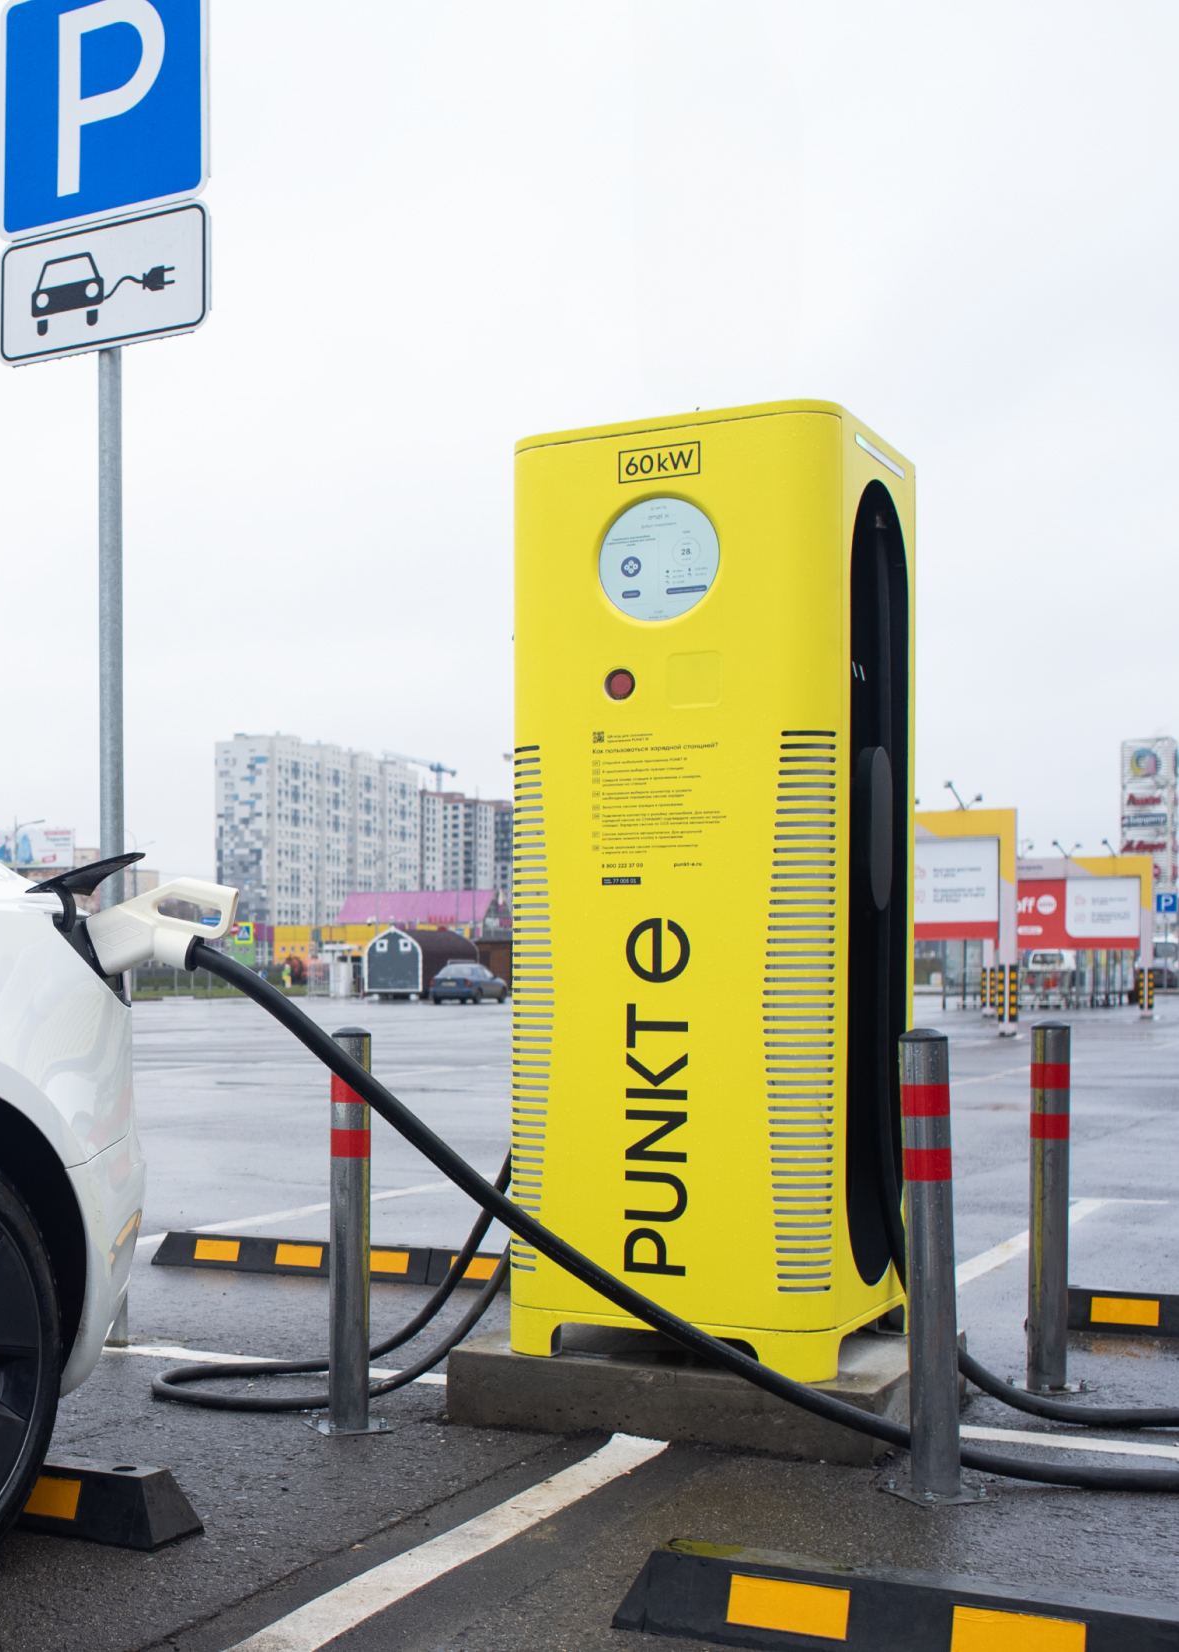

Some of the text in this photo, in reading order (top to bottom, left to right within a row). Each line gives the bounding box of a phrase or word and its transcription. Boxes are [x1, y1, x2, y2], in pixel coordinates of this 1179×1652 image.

[57, 0, 166, 197] P
[683, 742, 719, 750] станцией?
[623, 918, 690, 1276] PUNKT e
